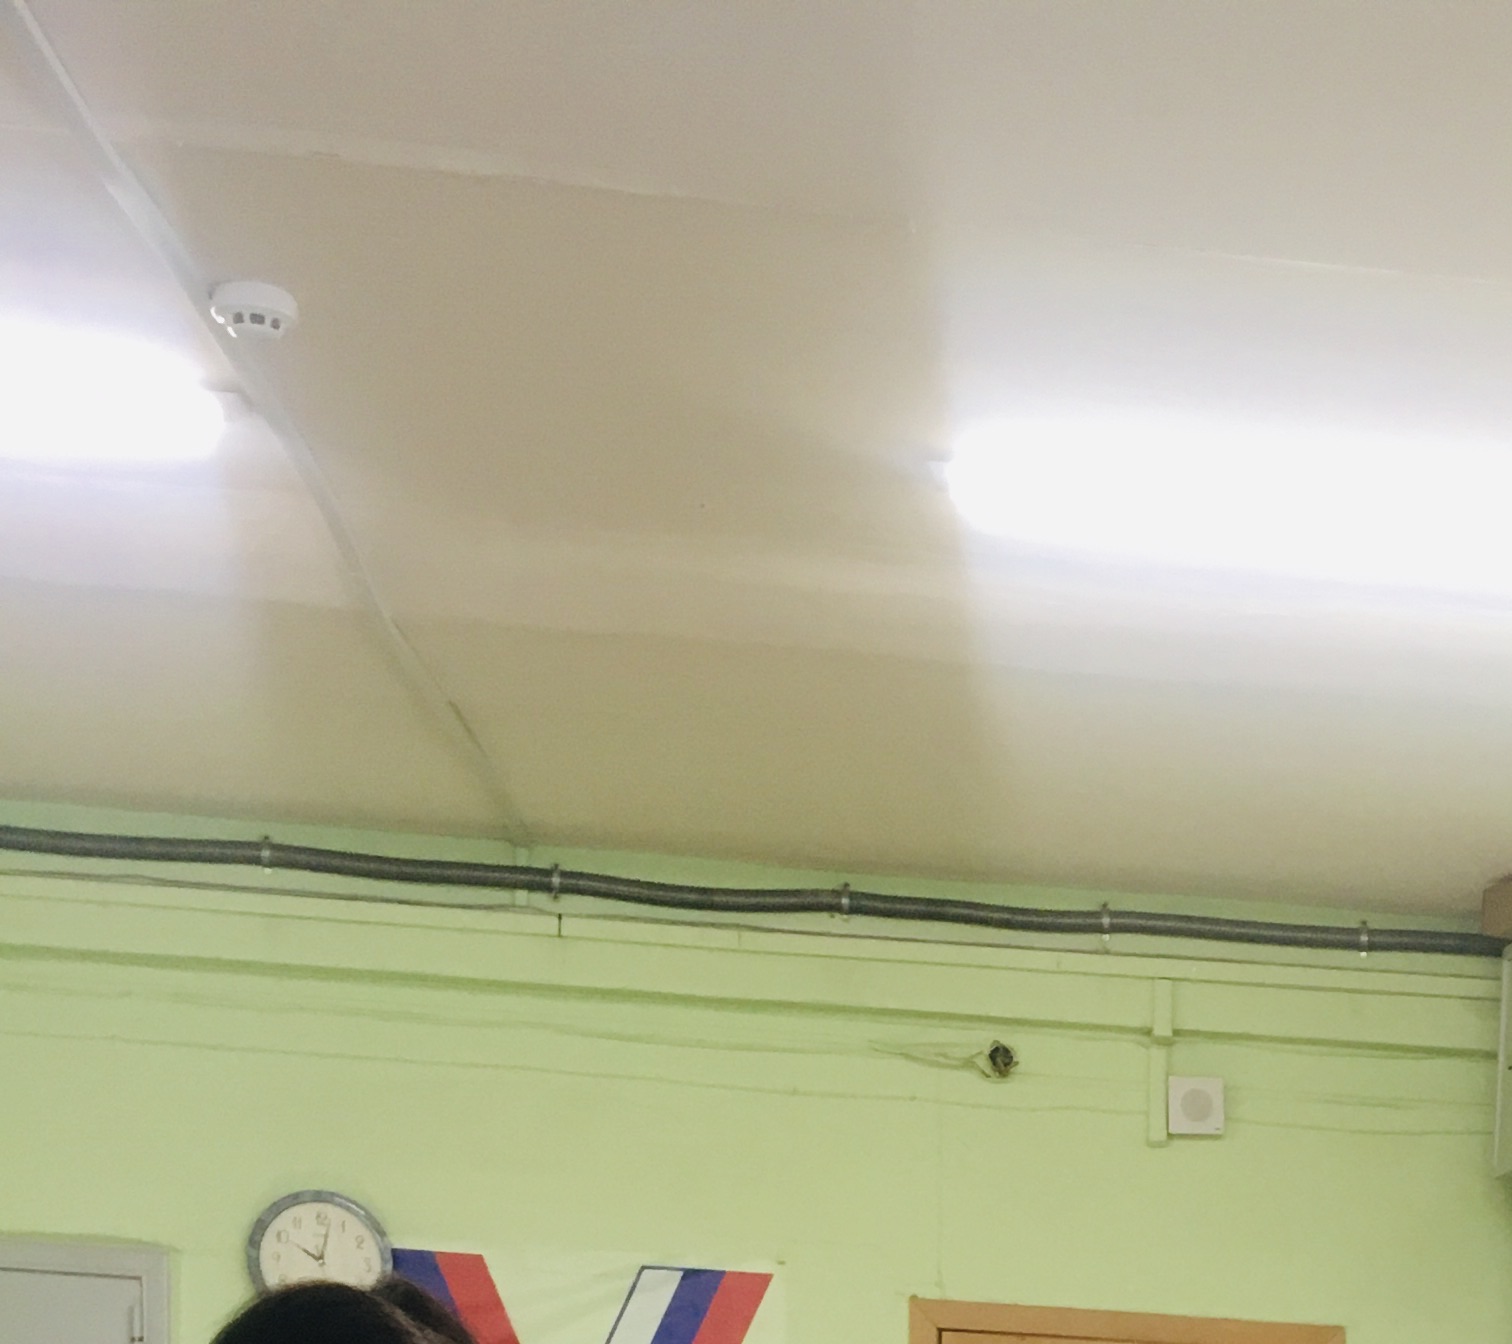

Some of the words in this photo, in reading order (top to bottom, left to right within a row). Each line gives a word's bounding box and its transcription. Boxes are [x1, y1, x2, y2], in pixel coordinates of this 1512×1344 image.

[292, 1216, 302, 1230] 11
[276, 1229, 289, 1244] 10
[355, 1235, 364, 1250] 2
